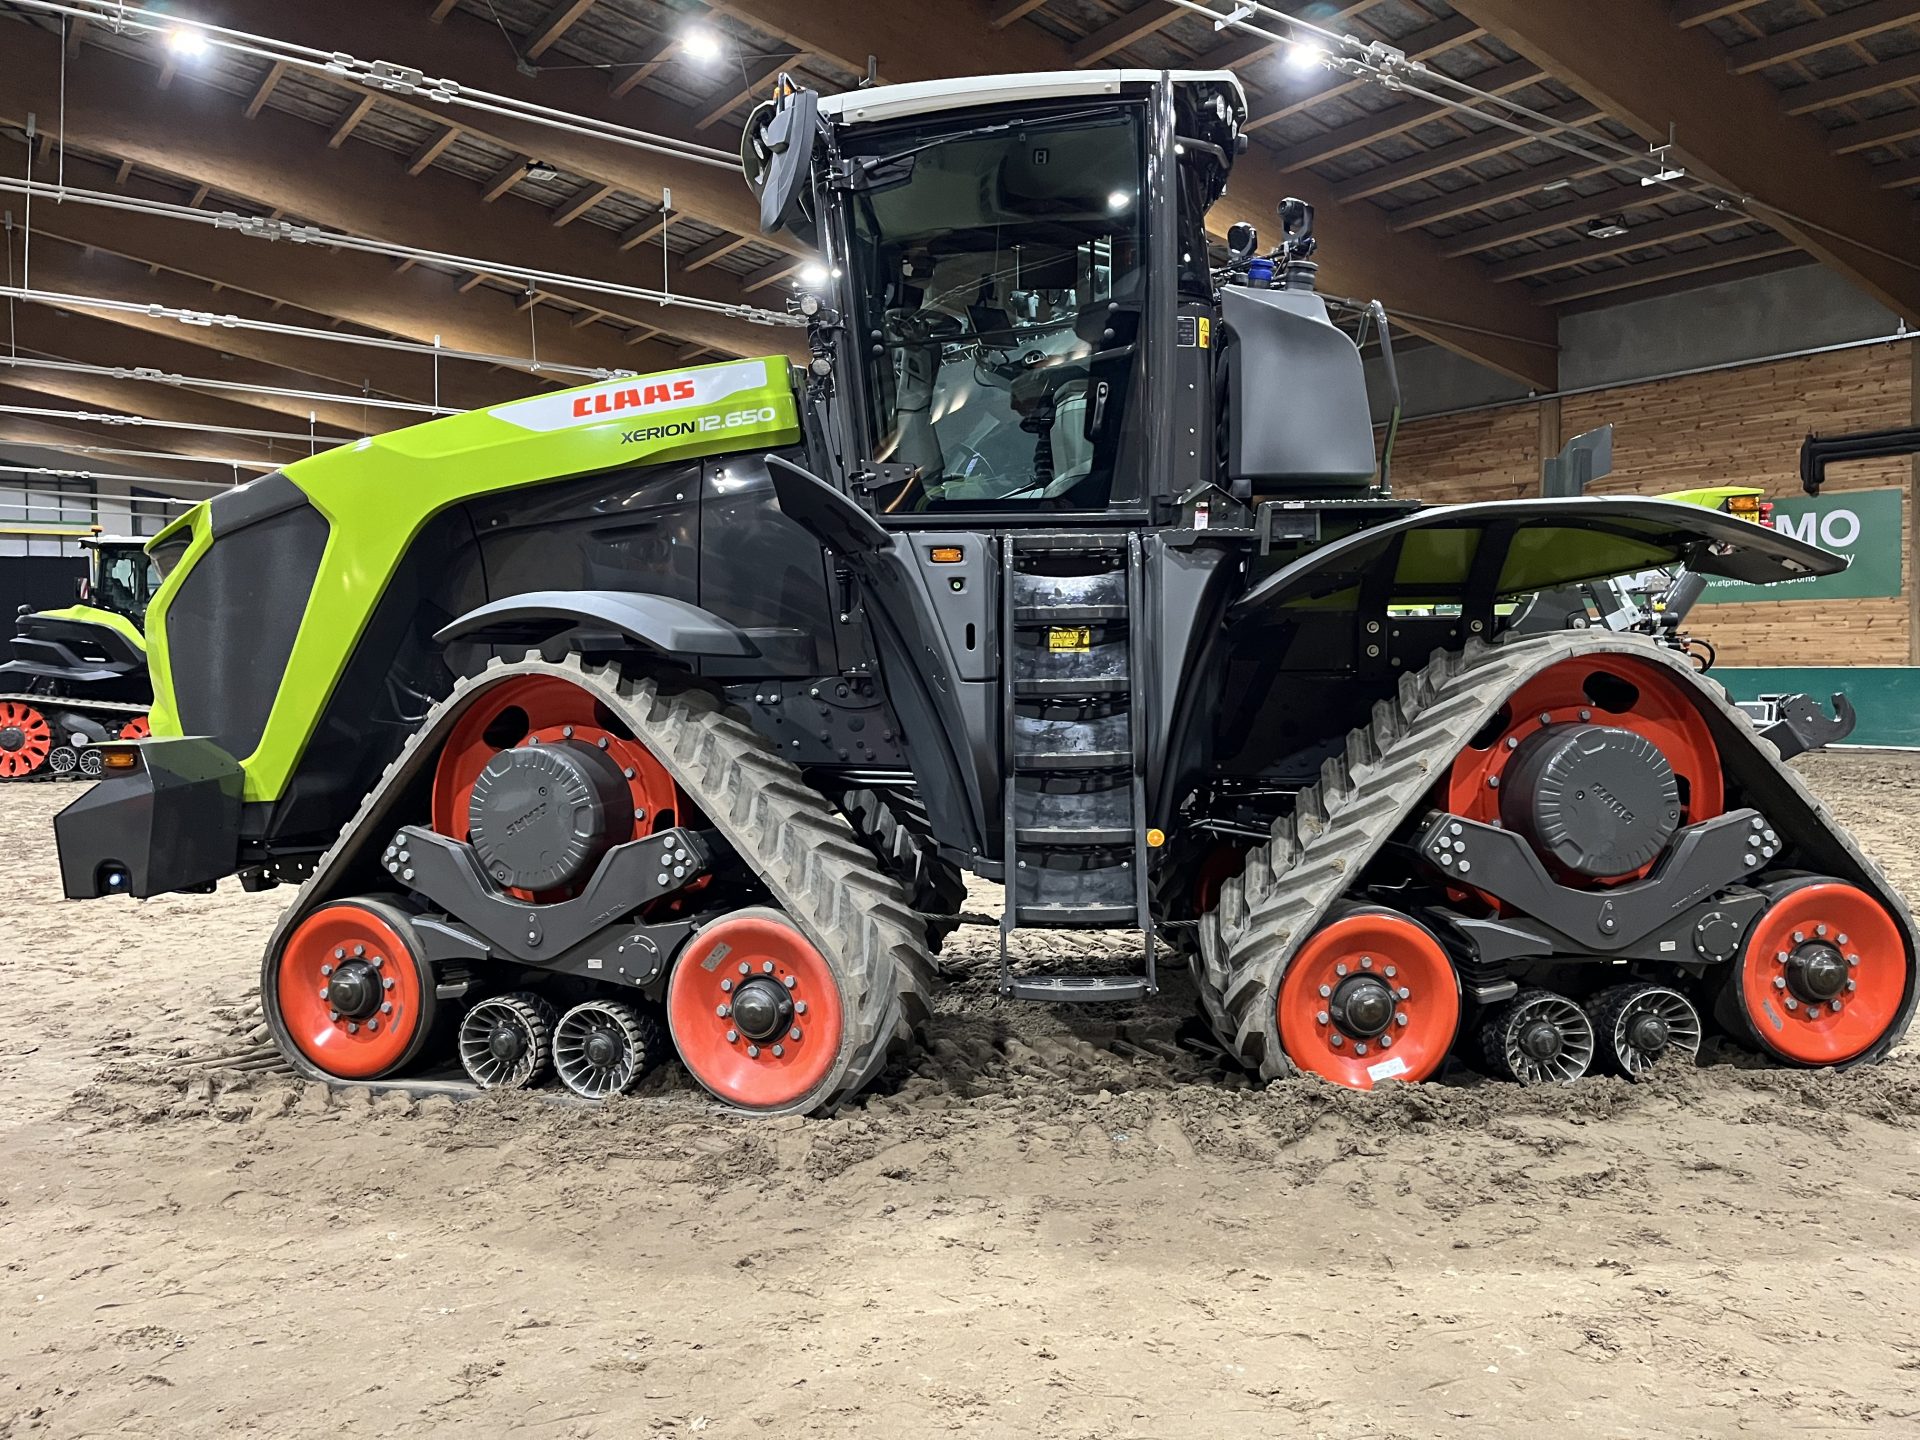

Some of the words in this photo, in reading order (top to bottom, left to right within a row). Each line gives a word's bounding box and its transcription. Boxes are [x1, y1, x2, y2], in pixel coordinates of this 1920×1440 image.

[572, 380, 695, 418] CLAAS
[620, 421, 695, 445] XERION
[697, 407, 775, 432] 12.650
